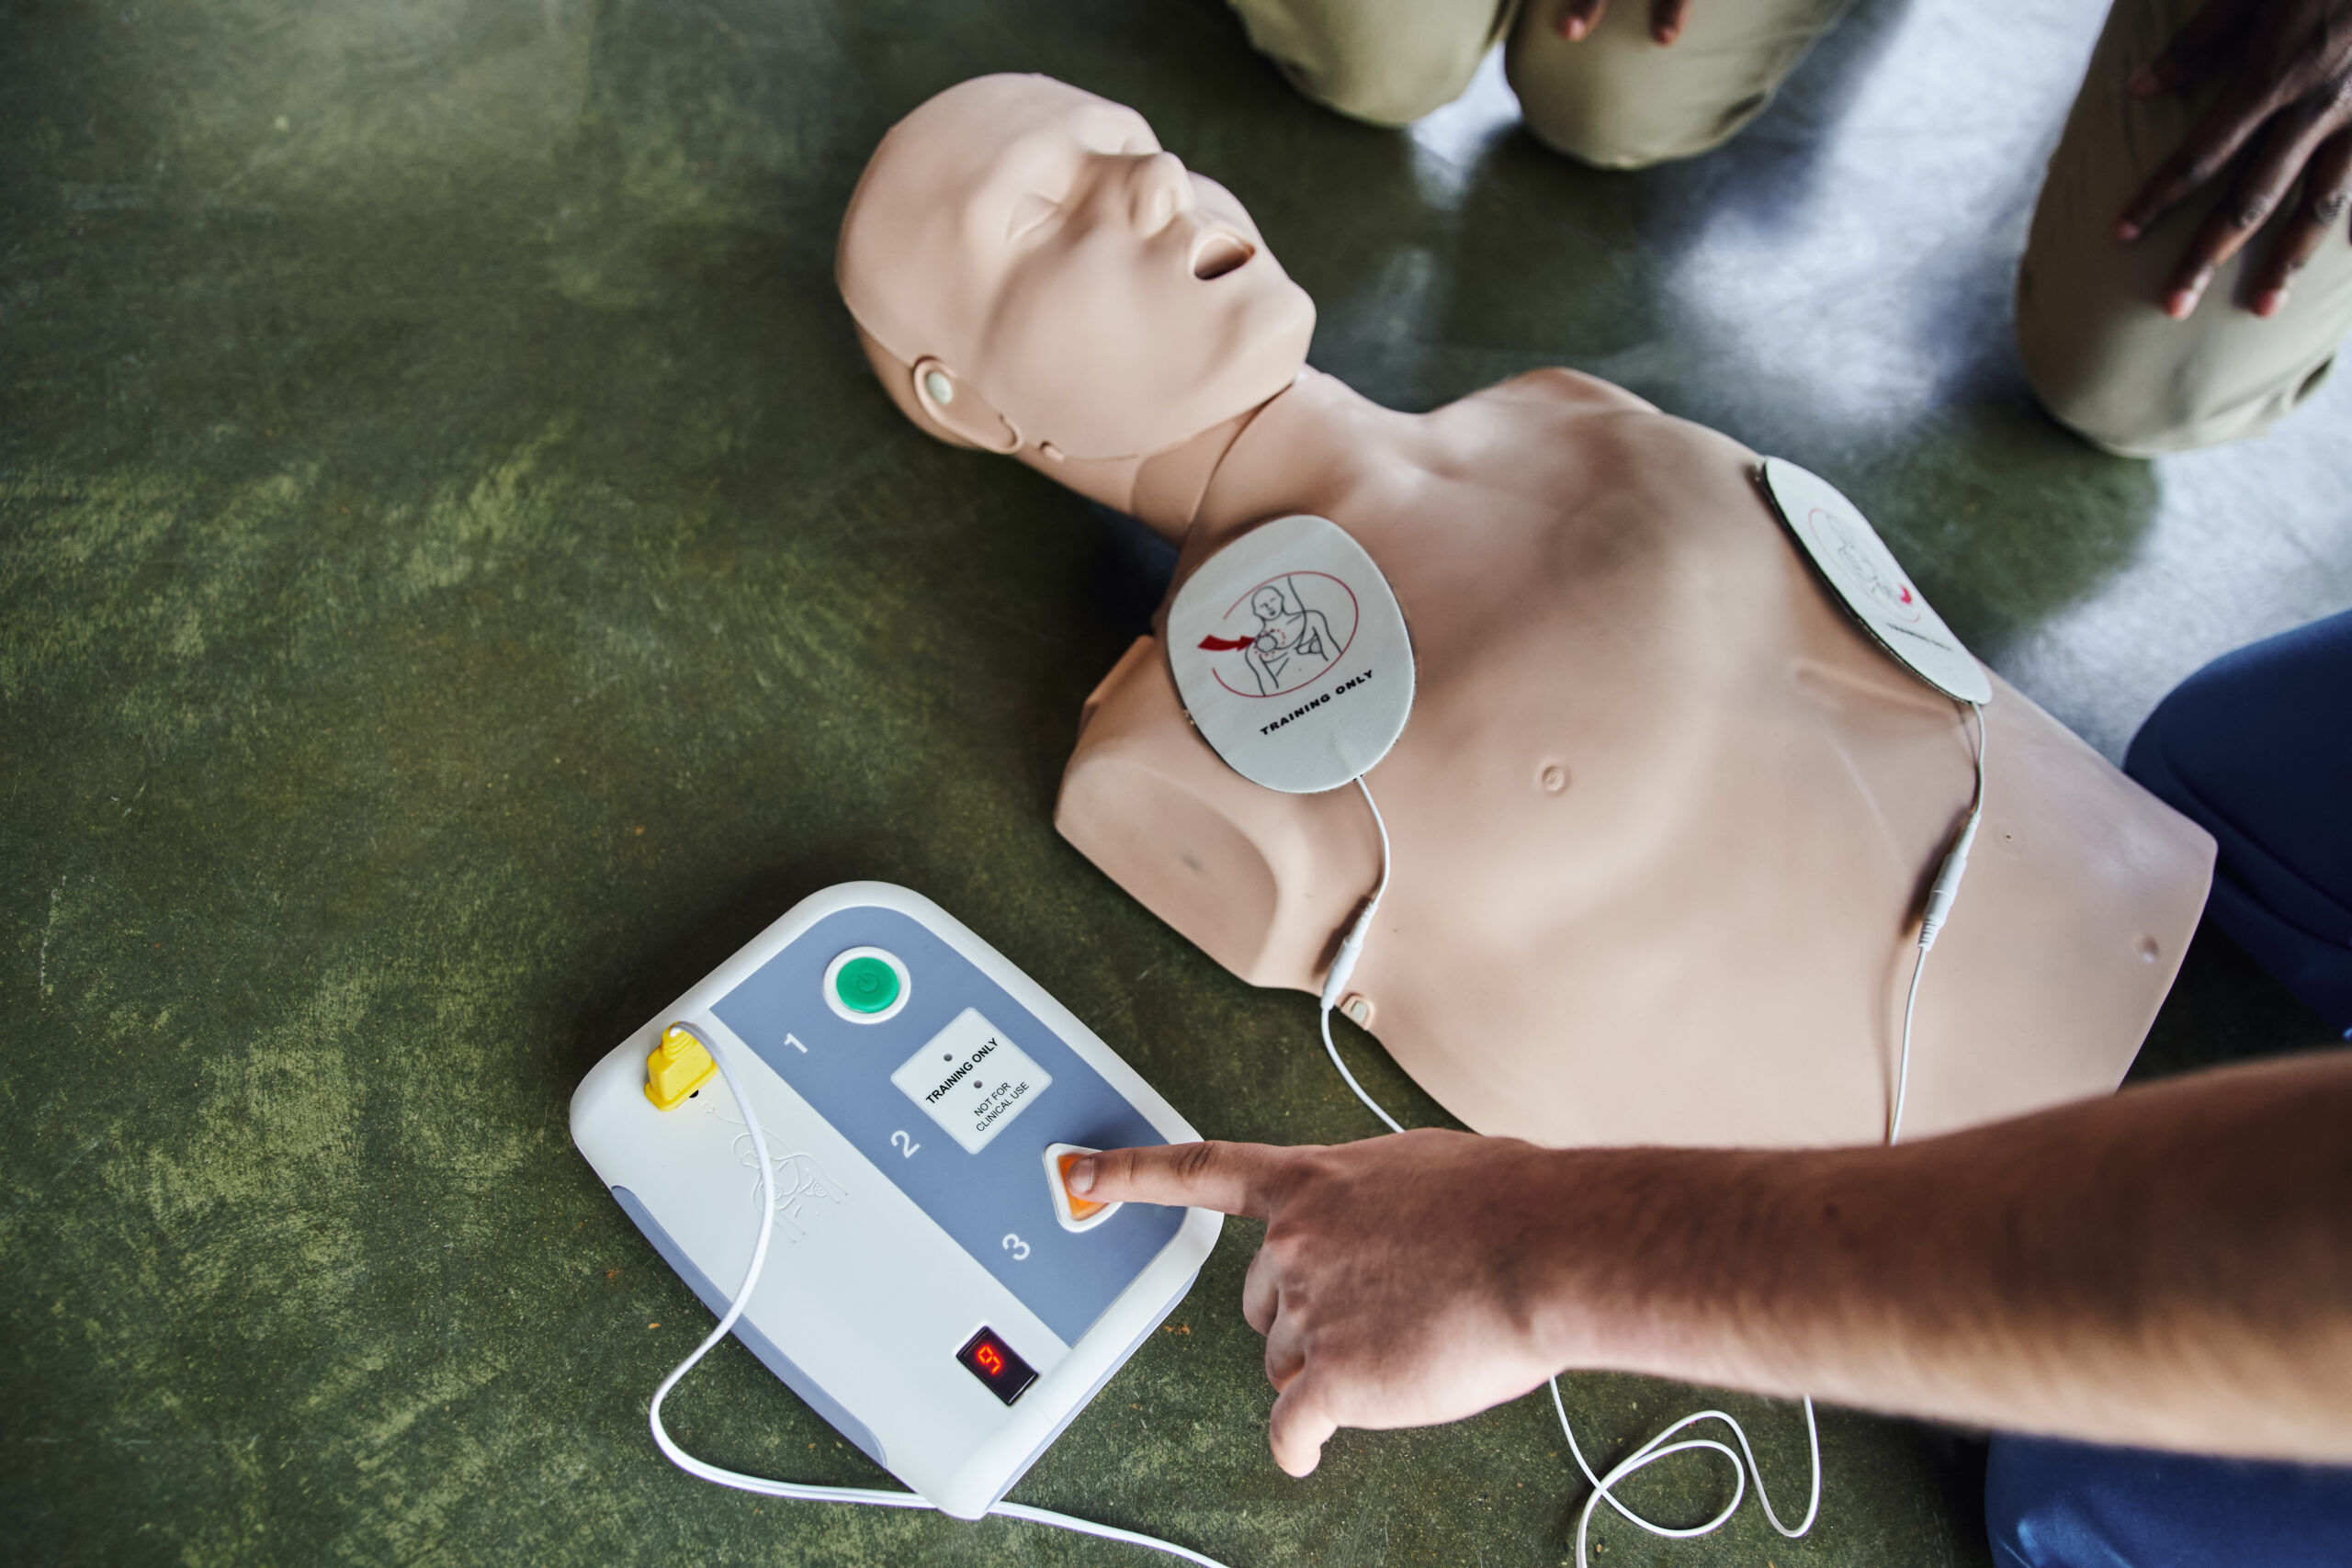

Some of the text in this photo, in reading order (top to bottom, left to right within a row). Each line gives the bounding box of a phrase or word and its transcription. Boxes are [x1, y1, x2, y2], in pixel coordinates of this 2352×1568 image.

[1260, 669, 1374, 736] TRAINING ONLY
[784, 1032, 808, 1054] 1
[925, 1037, 998, 1104] TRAINING ONLY
[974, 1082, 1012, 1117] NOT FOR
[976, 1081, 1030, 1132] CLINICAL USE
[890, 1130, 921, 1159] 2
[1002, 1234, 1030, 1260] 3
[977, 1344, 1001, 1374] 9
